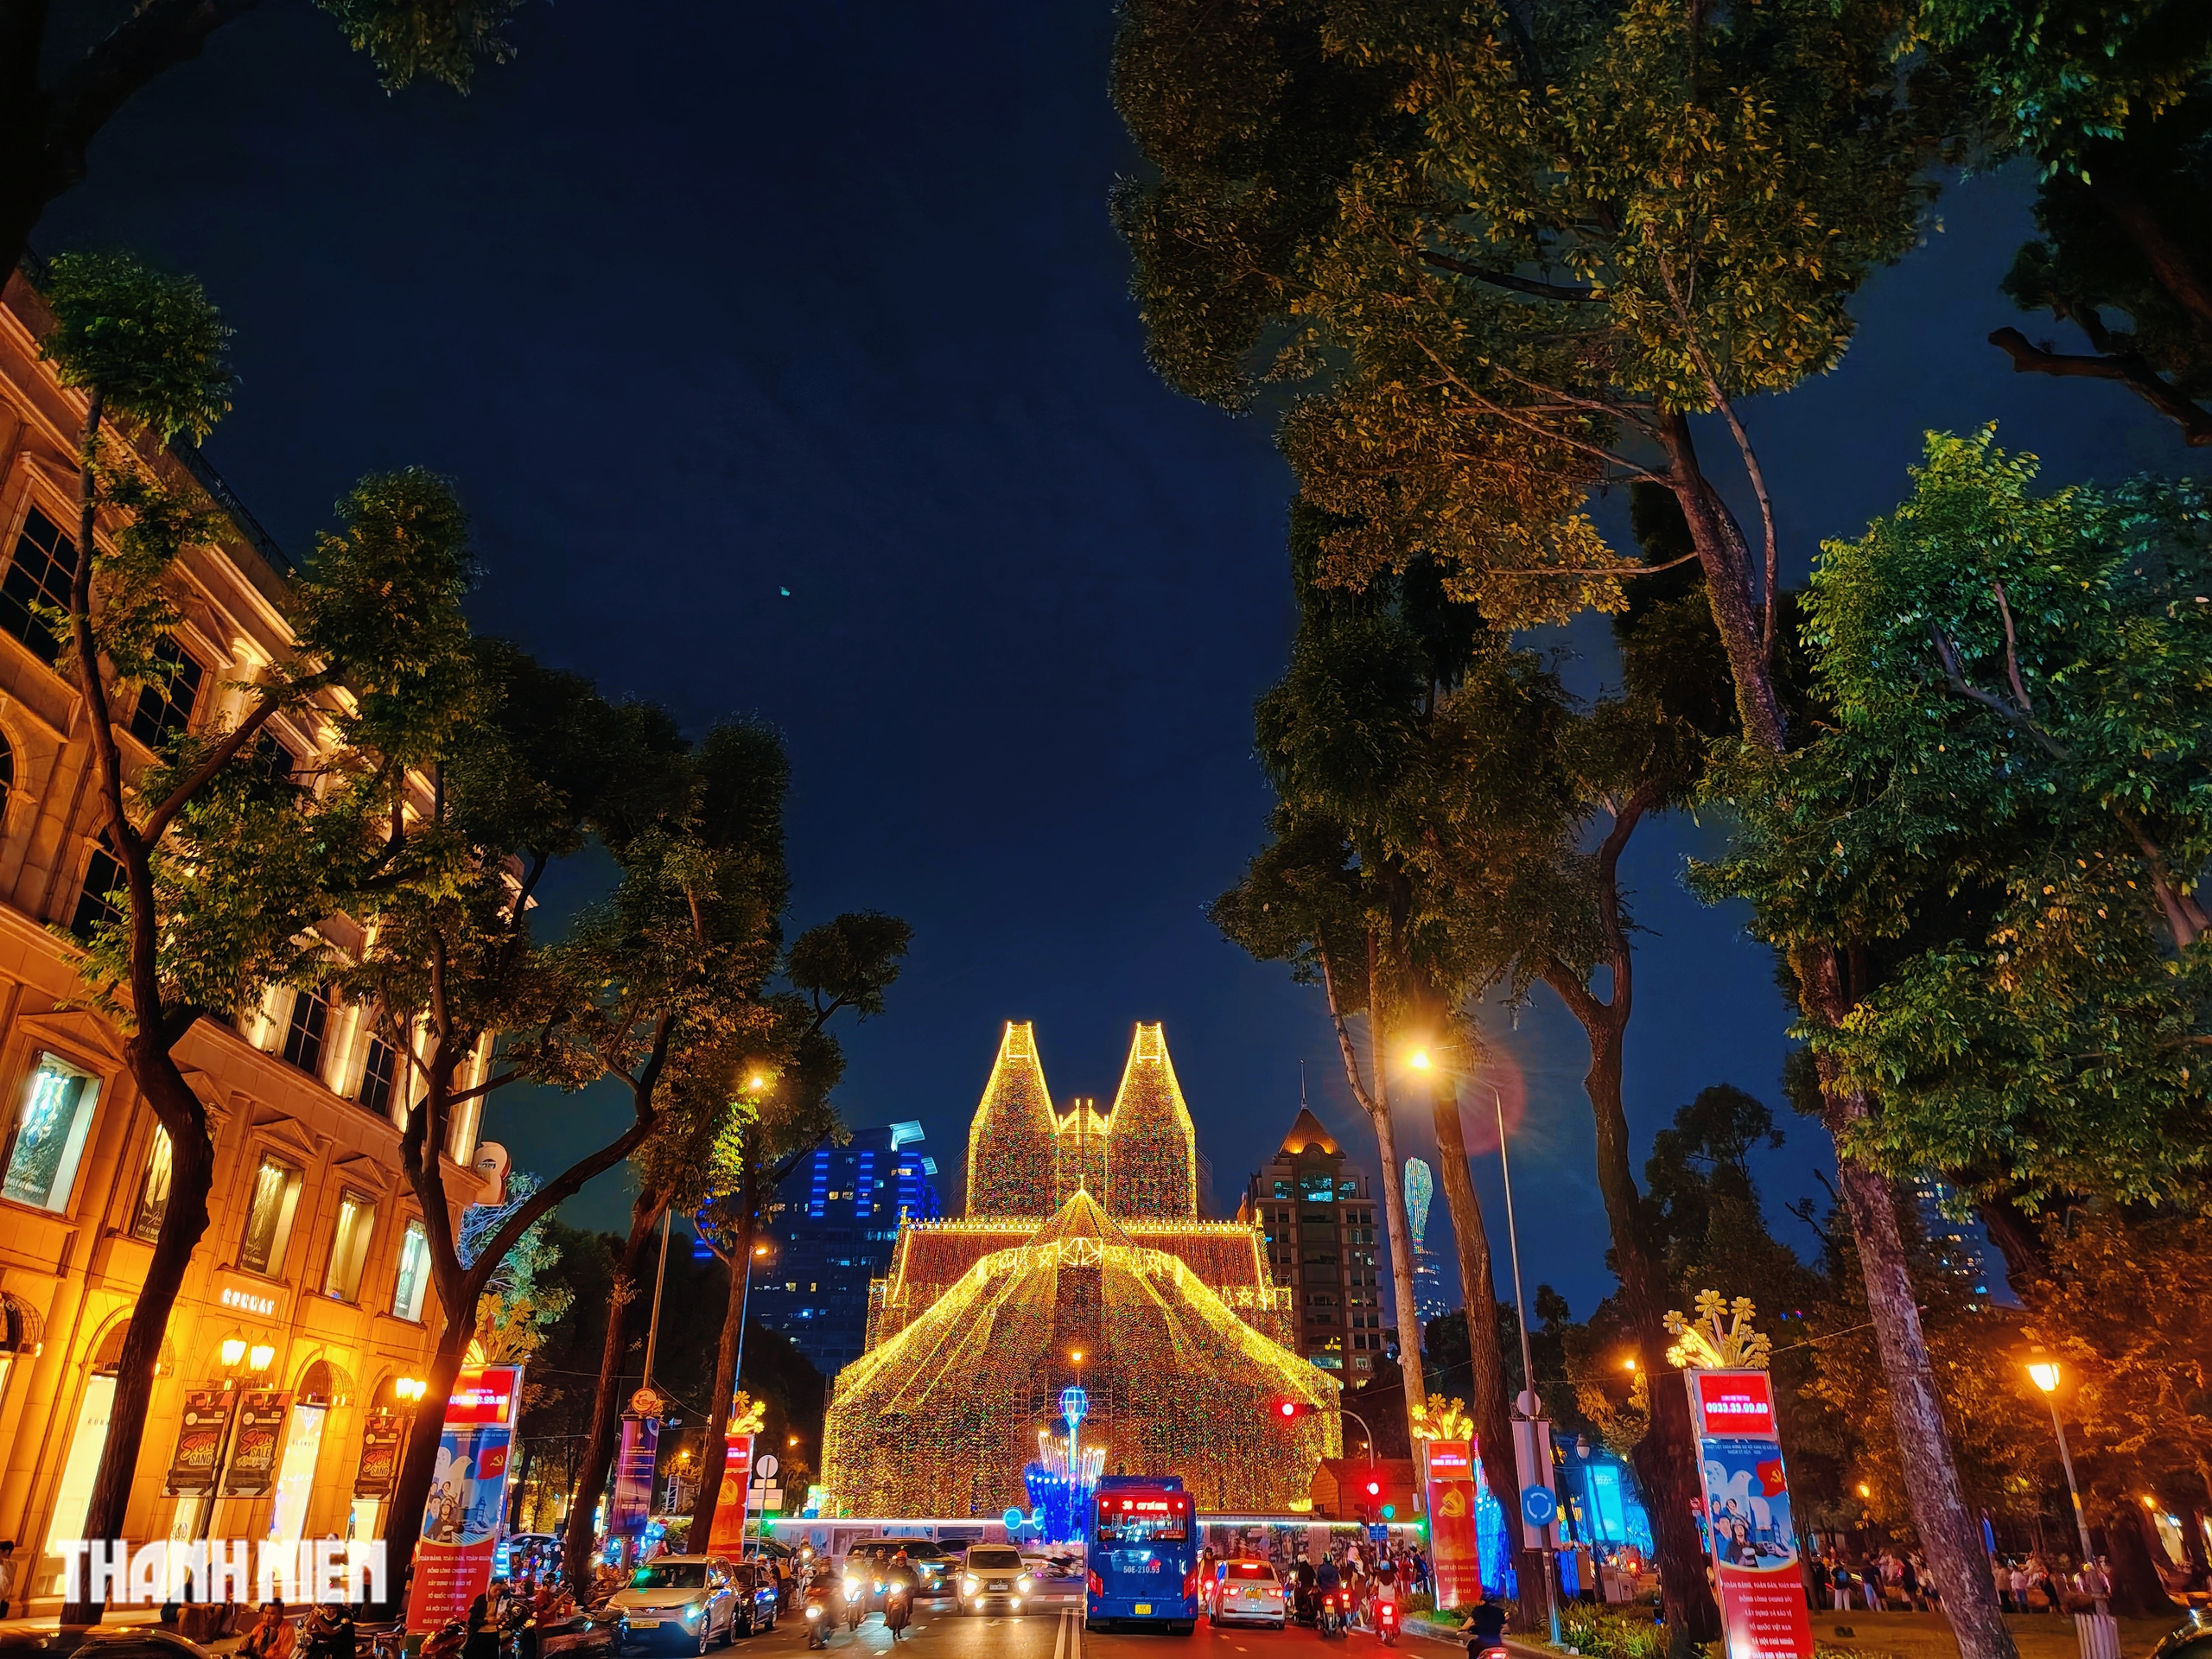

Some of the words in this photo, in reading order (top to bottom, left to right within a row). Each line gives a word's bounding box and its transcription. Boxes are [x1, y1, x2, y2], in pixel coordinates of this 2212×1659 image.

[251, 1447, 271, 1458] SALE
[190, 1453, 213, 1465] SANG
[371, 1466, 389, 1475] SANG
[1123, 1565, 1160, 1574] 50E-210.53
